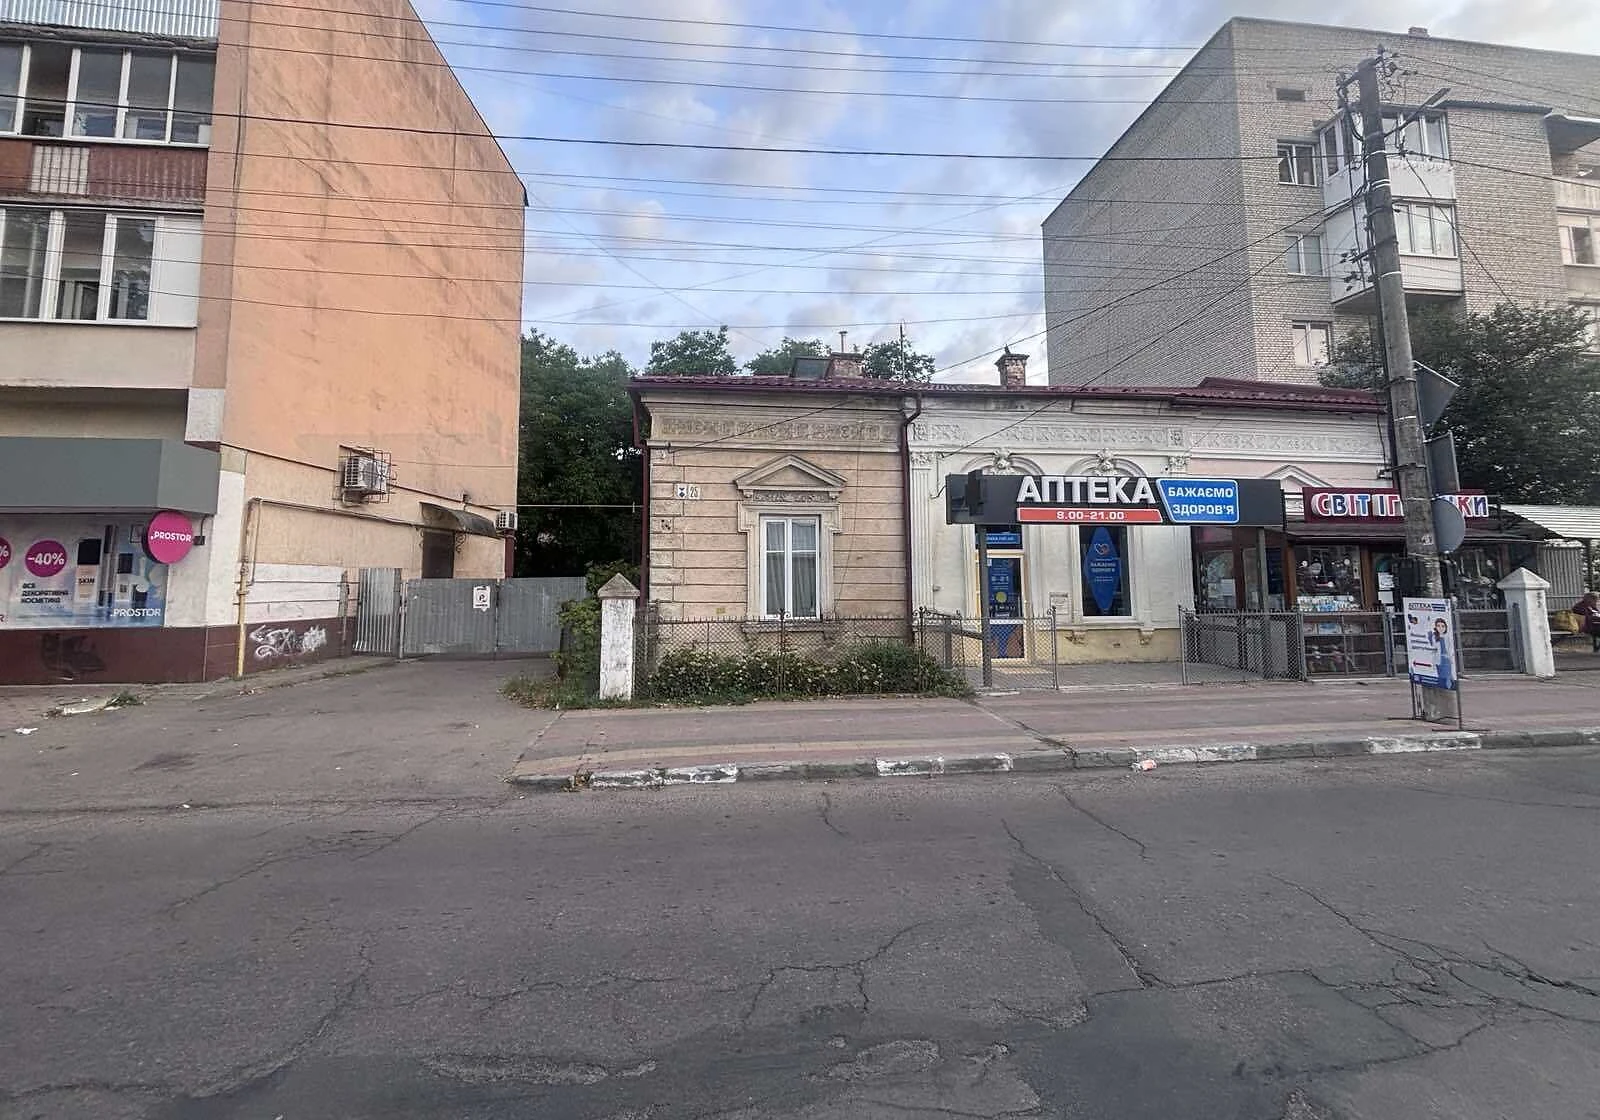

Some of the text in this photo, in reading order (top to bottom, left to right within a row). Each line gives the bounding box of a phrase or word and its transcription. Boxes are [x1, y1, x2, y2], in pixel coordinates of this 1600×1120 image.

[1016, 476, 1156, 503] АПТЕКА
[1168, 487, 1234, 498] БАЖАЄМО
[1173, 504, 1234, 515] ЗДОРОВ'Я
[1312, 493, 1489, 517] СВІТ ІГКИ
[1056, 511, 1125, 520] 8.00-21.00
[28, 553, 65, 566] -40%
